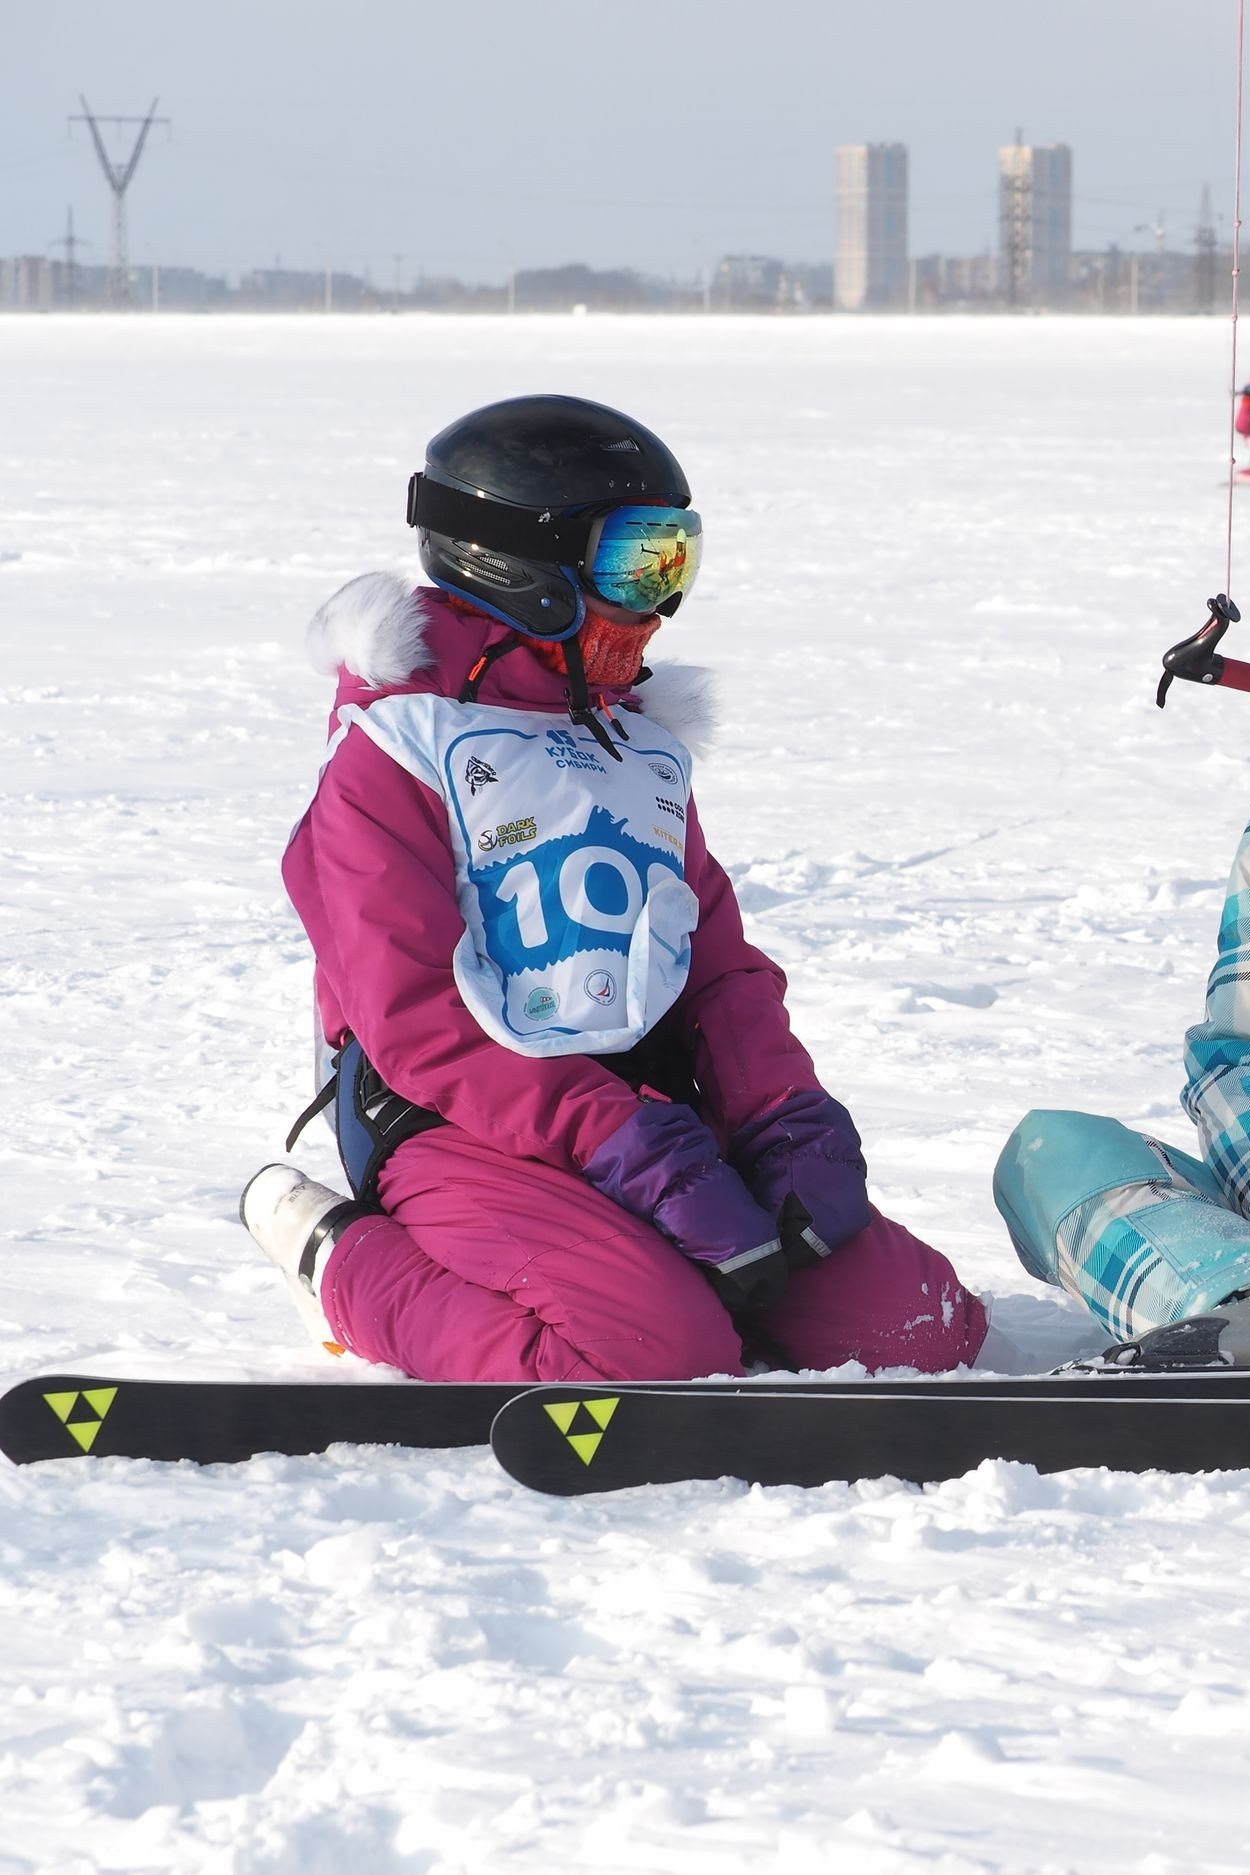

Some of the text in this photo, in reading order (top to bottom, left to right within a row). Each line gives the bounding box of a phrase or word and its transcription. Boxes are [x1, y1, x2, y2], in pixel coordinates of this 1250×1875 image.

[545, 746, 600, 763] КУБОК
[556, 759, 607, 774] СИБИРИ
[496, 816, 537, 836] DARK
[498, 827, 537, 848] FOILS
[494, 846, 684, 949] 10
